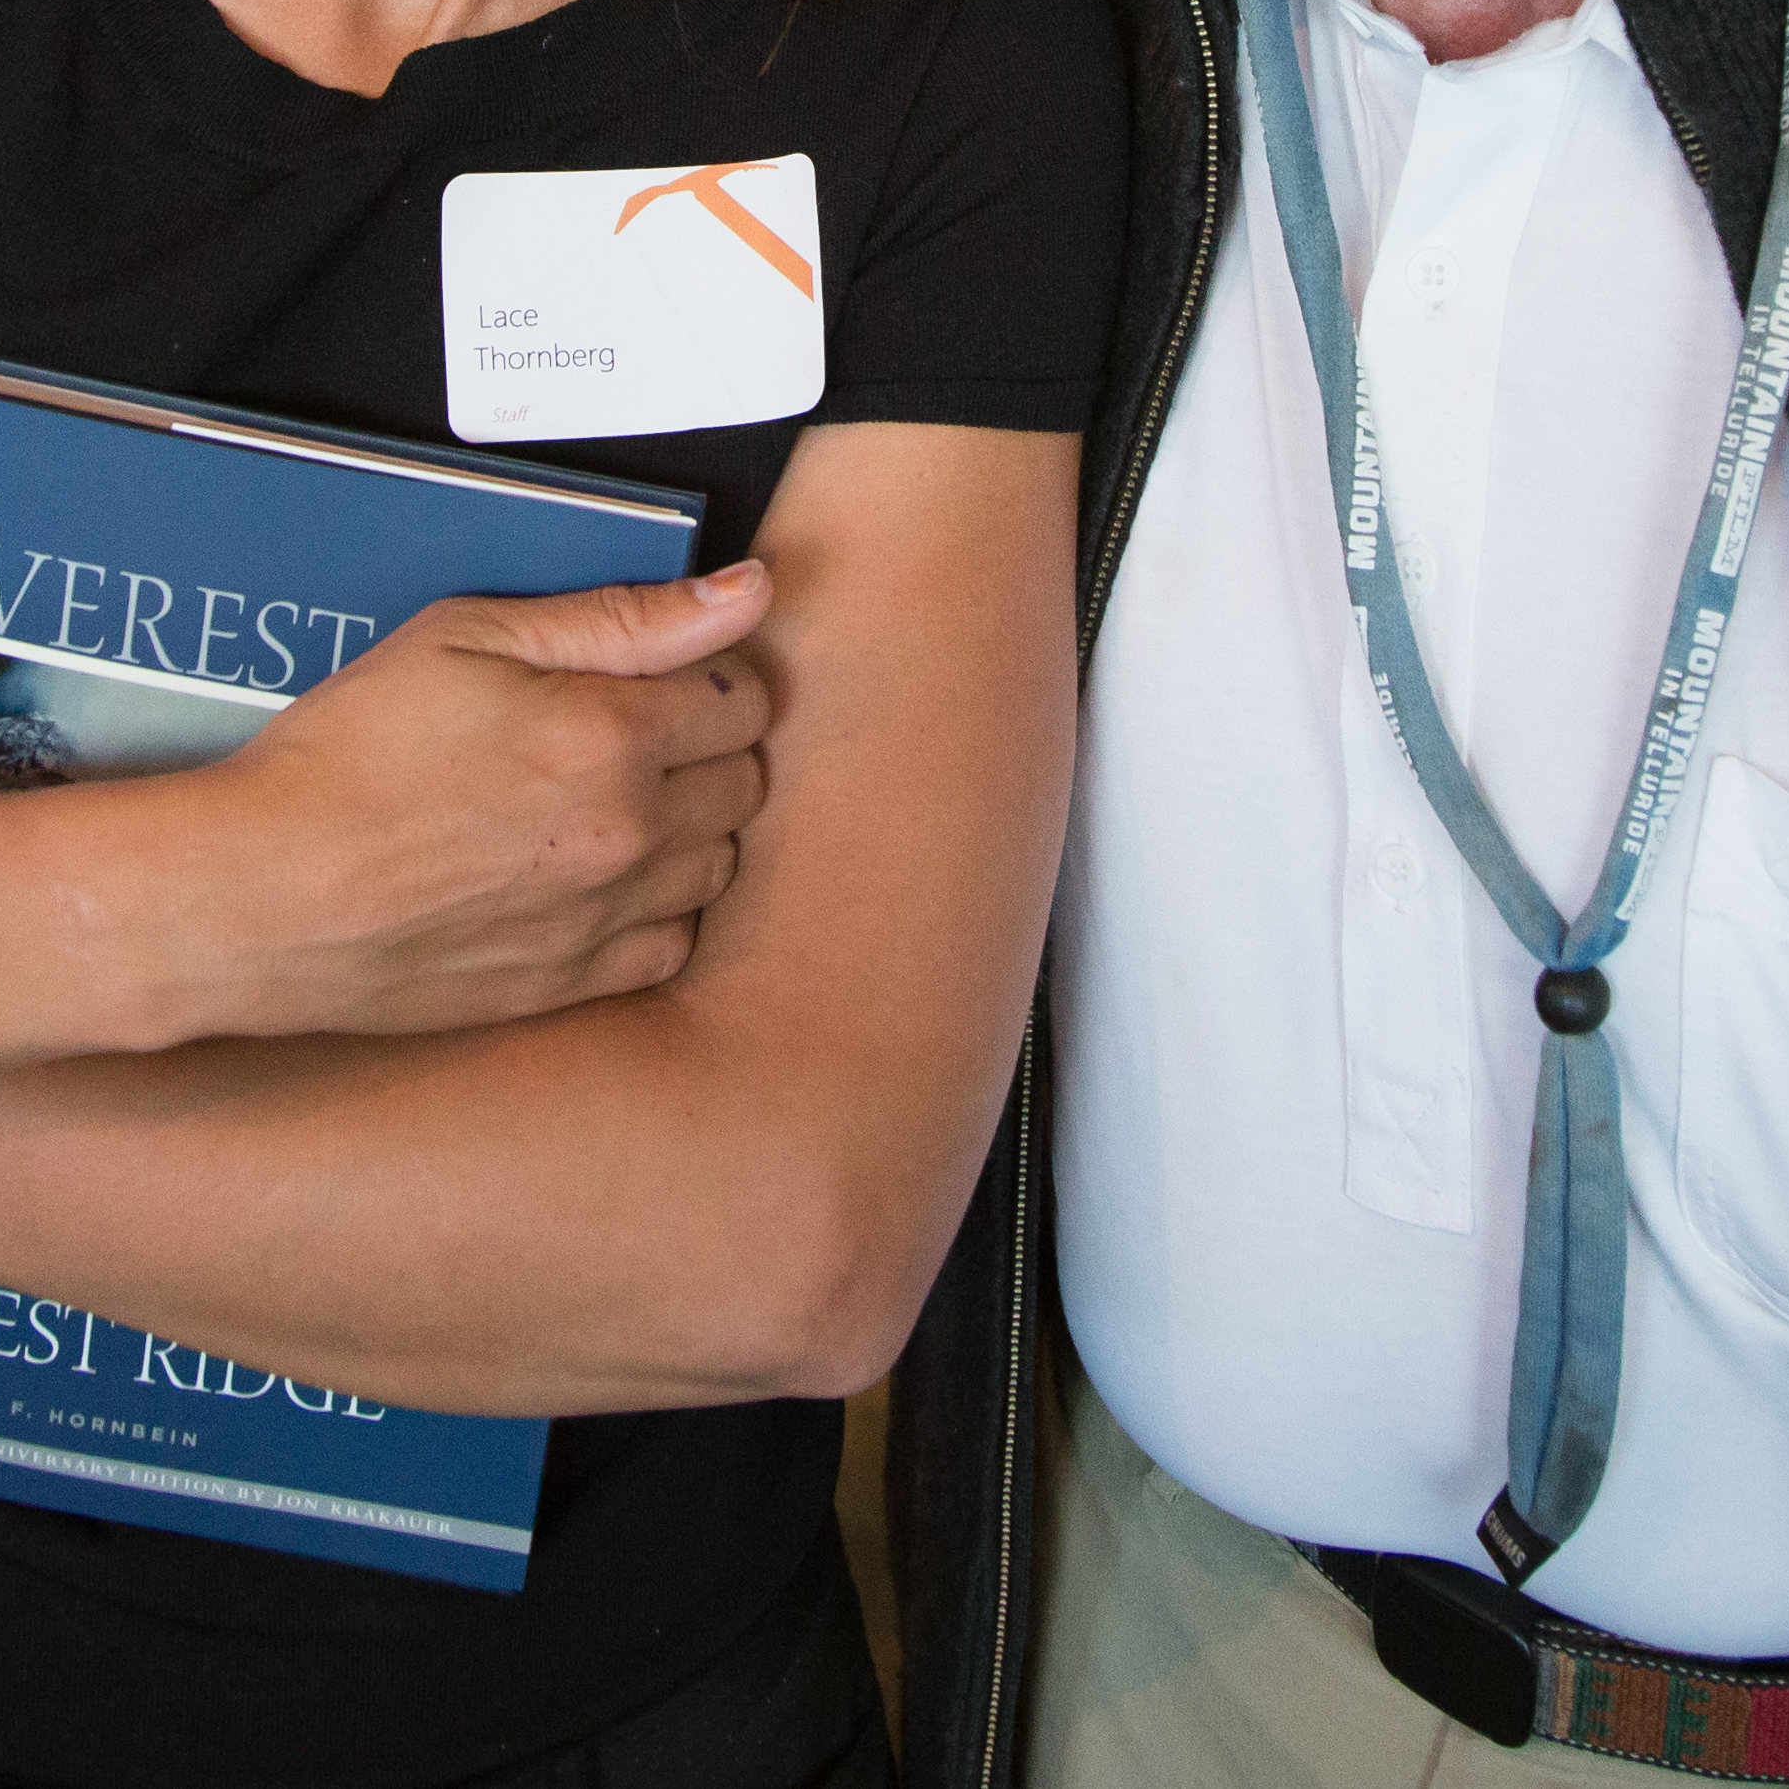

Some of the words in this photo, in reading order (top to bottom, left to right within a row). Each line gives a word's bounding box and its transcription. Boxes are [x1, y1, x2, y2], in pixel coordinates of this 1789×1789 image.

[478, 305, 539, 329] Lace
[1750, 305, 1771, 333] IN
[472, 342, 615, 373] Thornberg
[490, 405, 531, 424] Staff
[1711, 346, 1762, 499] TELLURIDE
[1660, 667, 1684, 700] IN
[1652, 607, 1726, 819] MOUNTAIN
[1622, 709, 1676, 858] TELLURIDE
[10, 1399, 32, 1420] F.
[48, 1407, 199, 1448] HORNBEIN
[128, 1467, 226, 1496] EDITION
[237, 1485, 266, 1503] BY
[274, 1492, 319, 1512] JON
[330, 1500, 453, 1536] KRAKAUER
